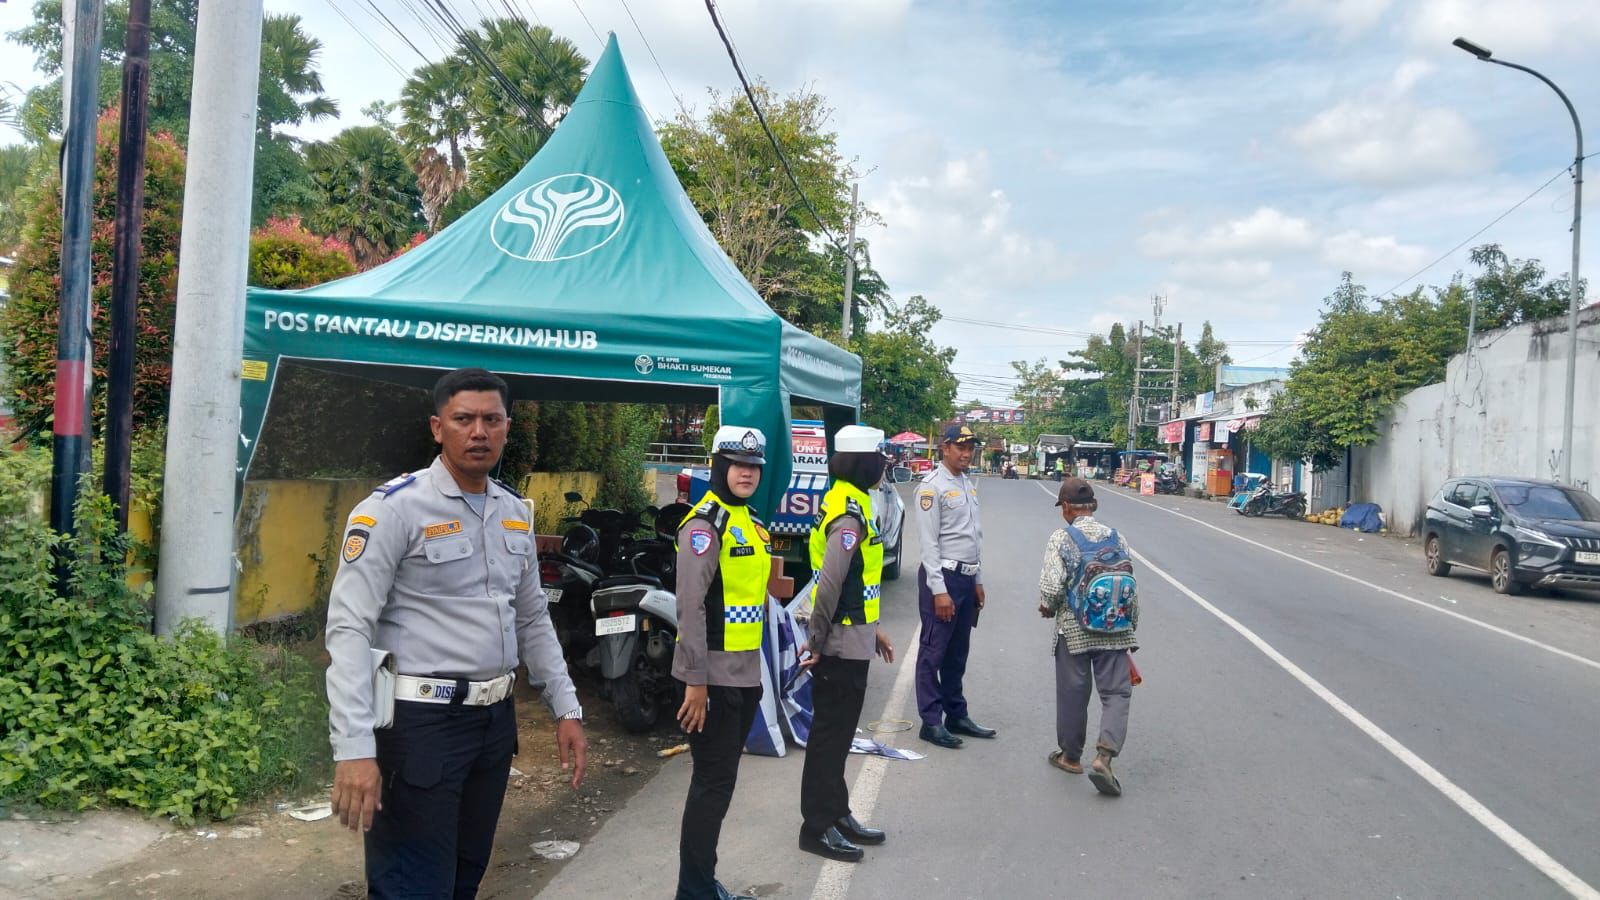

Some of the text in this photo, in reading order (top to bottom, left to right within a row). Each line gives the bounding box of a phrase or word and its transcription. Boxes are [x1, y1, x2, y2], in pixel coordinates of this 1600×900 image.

[264, 310, 598, 350] POS PANTAU DISPERKIMHUB
[657, 362, 732, 374] BHAKTI SUMEKAR
